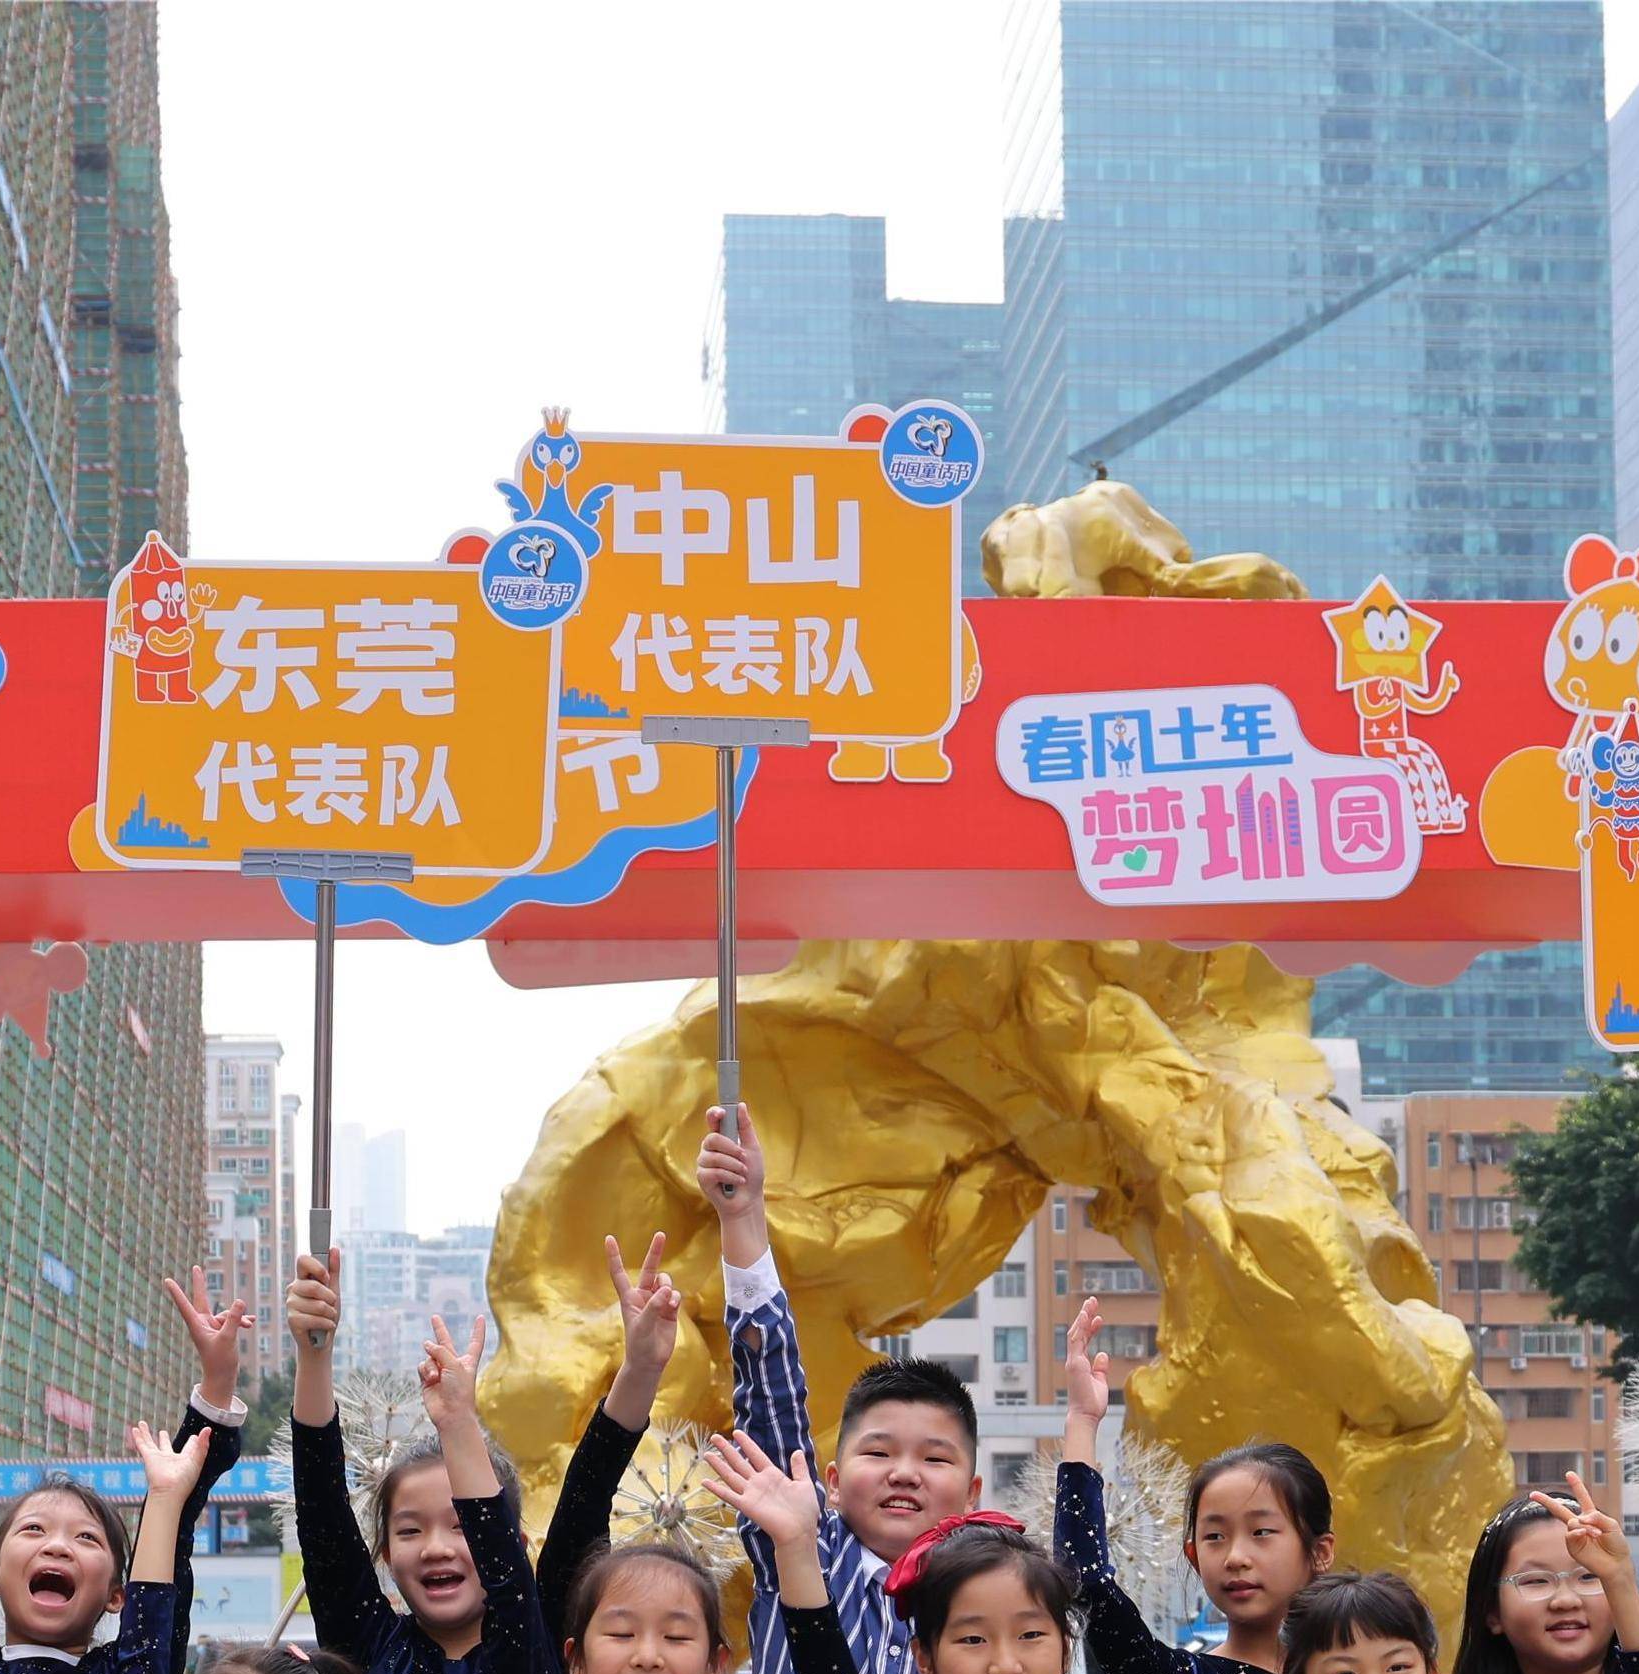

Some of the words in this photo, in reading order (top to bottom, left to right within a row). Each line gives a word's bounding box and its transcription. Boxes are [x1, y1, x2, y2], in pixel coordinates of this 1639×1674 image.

[891, 461, 969, 483] 中国童话节
[613, 471, 860, 588] 中山
[490, 583, 572, 604] 中国童话节
[201, 596, 458, 715] 东莞
[610, 613, 874, 696] 代表队
[195, 741, 462, 826] 代表队
[1021, 703, 1293, 783] 春风十年
[1082, 773, 1406, 891] 梦圳圆
